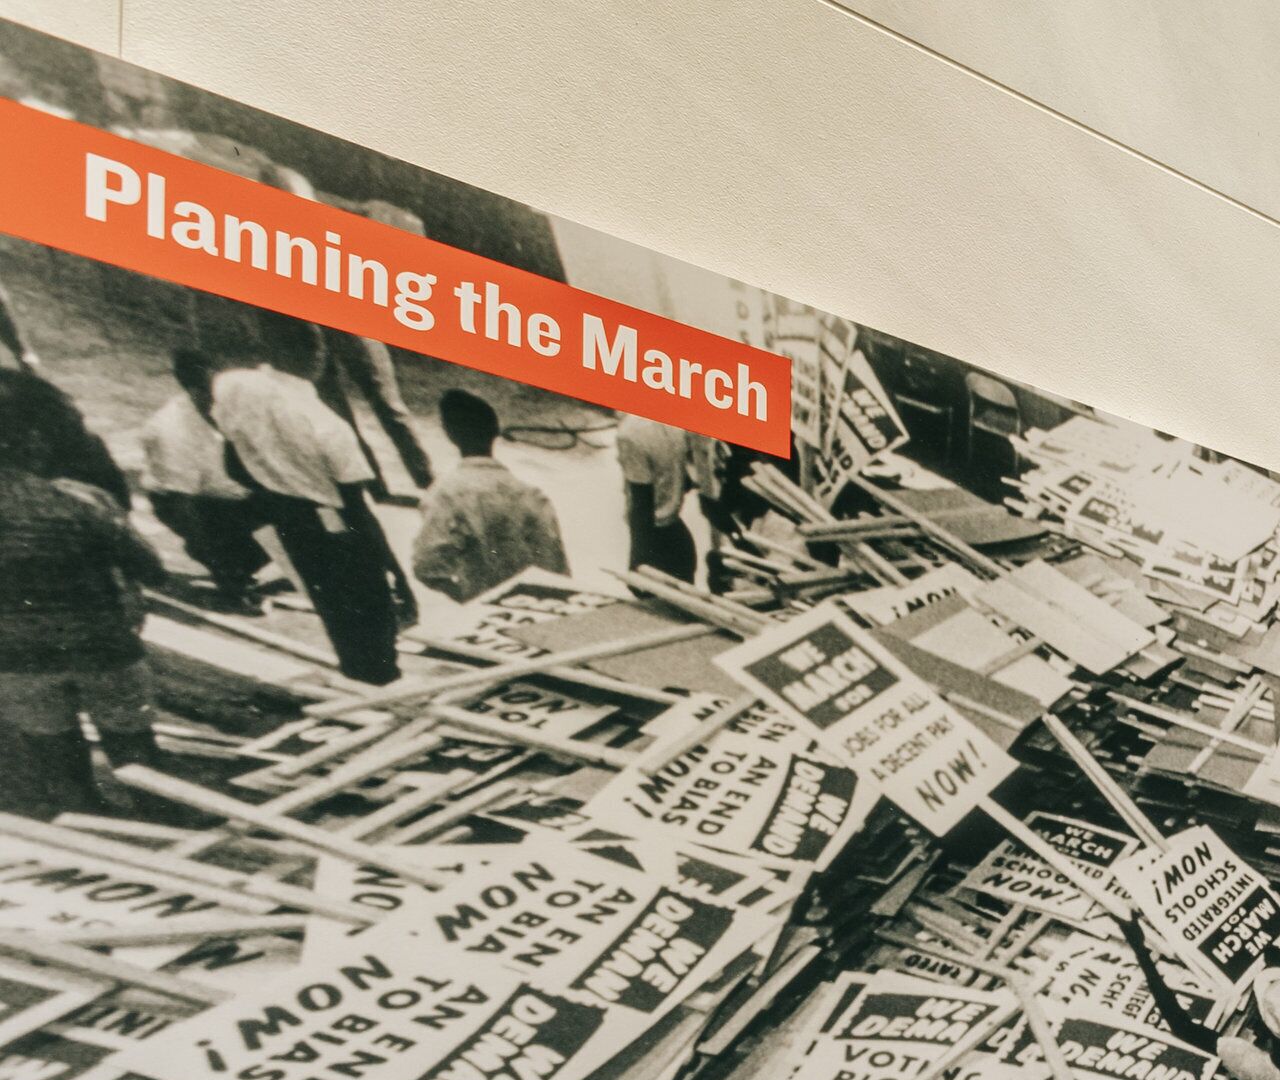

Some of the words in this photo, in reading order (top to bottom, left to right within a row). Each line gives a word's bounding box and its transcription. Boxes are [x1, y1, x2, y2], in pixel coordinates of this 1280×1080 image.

[84, 151, 436, 331] Planning
[453, 280, 562, 358] the
[582, 314, 769, 422] March
[195, 955, 392, 1071] NOW!
[378, 975, 453, 1011] TO
[413, 985, 489, 1032] AN
